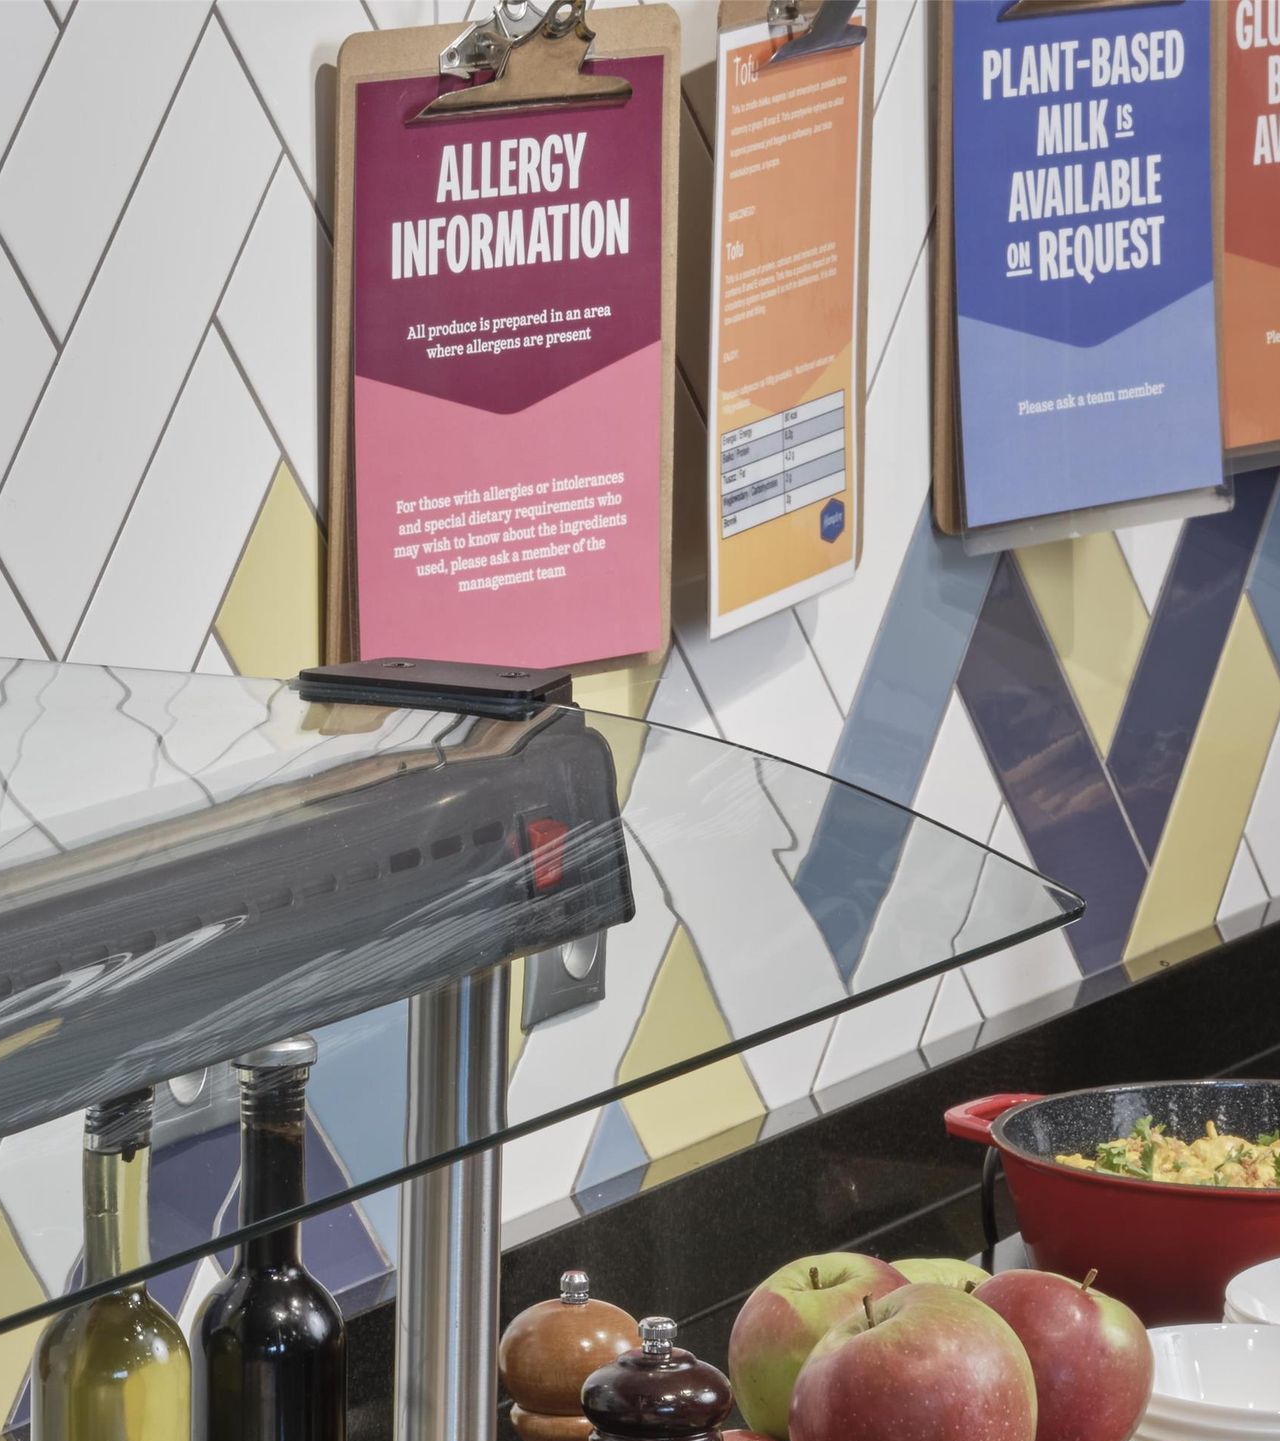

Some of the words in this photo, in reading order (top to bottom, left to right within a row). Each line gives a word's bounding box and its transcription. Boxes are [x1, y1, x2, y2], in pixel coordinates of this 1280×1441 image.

[733, 54, 759, 87] Tofu
[982, 29, 1185, 100] PLANT-BASED
[1037, 98, 1109, 156] MILK
[1115, 103, 1134, 138] IS
[436, 132, 587, 203] ALLERGY
[1008, 154, 1162, 223] AVAILABLE
[391, 198, 629, 279] INFORMATION
[725, 240, 744, 261] Tofu
[1006, 241, 1032, 277] ON
[1039, 215, 1165, 284] REQUEST
[407, 324, 425, 340] All
[428, 318, 477, 341] produce
[479, 317, 490, 332] is
[492, 310, 547, 333] prepared
[550, 308, 563, 323] in
[566, 309, 581, 321] an
[584, 305, 611, 319] area
[427, 342, 463, 359] where
[466, 336, 521, 355] allergens
[523, 335, 543, 348] are
[546, 326, 592, 347] present
[1018, 399, 1054, 415] Please
[1056, 394, 1077, 410] ask
[1078, 396, 1085, 406] a
[1087, 390, 1115, 405] team
[1118, 382, 1165, 400] member
[396, 500, 416, 514] For
[418, 495, 451, 512] those
[454, 489, 481, 506] with
[483, 484, 534, 504] allergies
[536, 482, 549, 495] or
[552, 472, 625, 494] intolerances
[398, 519, 422, 536] and
[424, 513, 466, 535] special
[468, 507, 512, 527] dietary
[515, 495, 595, 521] requirements
[598, 491, 622, 508] who
[394, 544, 420, 560] may
[422, 536, 451, 554] wish
[454, 536, 466, 550] to
[468, 531, 500, 548] know
[502, 526, 536, 543] about
[537, 522, 557, 538] the
[560, 513, 627, 535] ingredients
[417, 559, 448, 577] used,
[450, 552, 488, 575] please
[489, 549, 510, 566] ask
[512, 552, 520, 563] a
[522, 540, 571, 561] member
[572, 537, 586, 553] of
[587, 535, 606, 551] the
[458, 566, 534, 593] management
[536, 563, 566, 581] team
